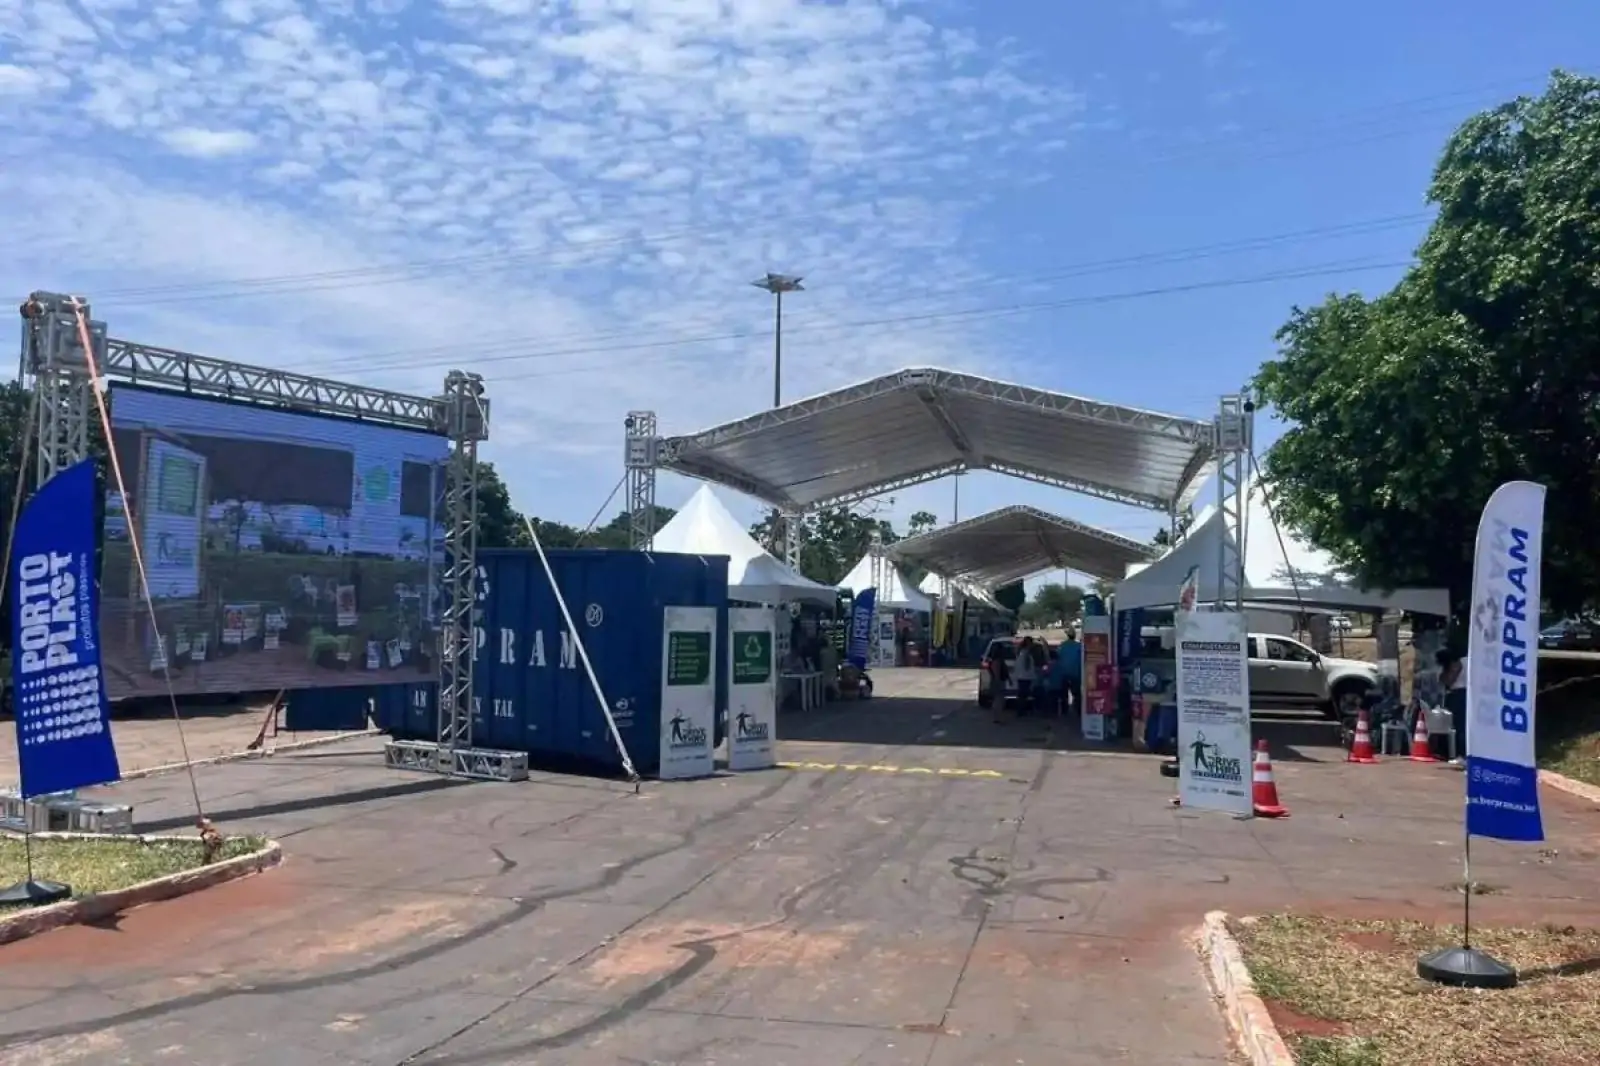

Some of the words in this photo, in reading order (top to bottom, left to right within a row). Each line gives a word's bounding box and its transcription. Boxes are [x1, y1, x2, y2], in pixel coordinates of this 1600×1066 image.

[20, 553, 51, 674] PORTO
[46, 551, 78, 668] PLACT
[1499, 527, 1529, 733] BERPRAM
